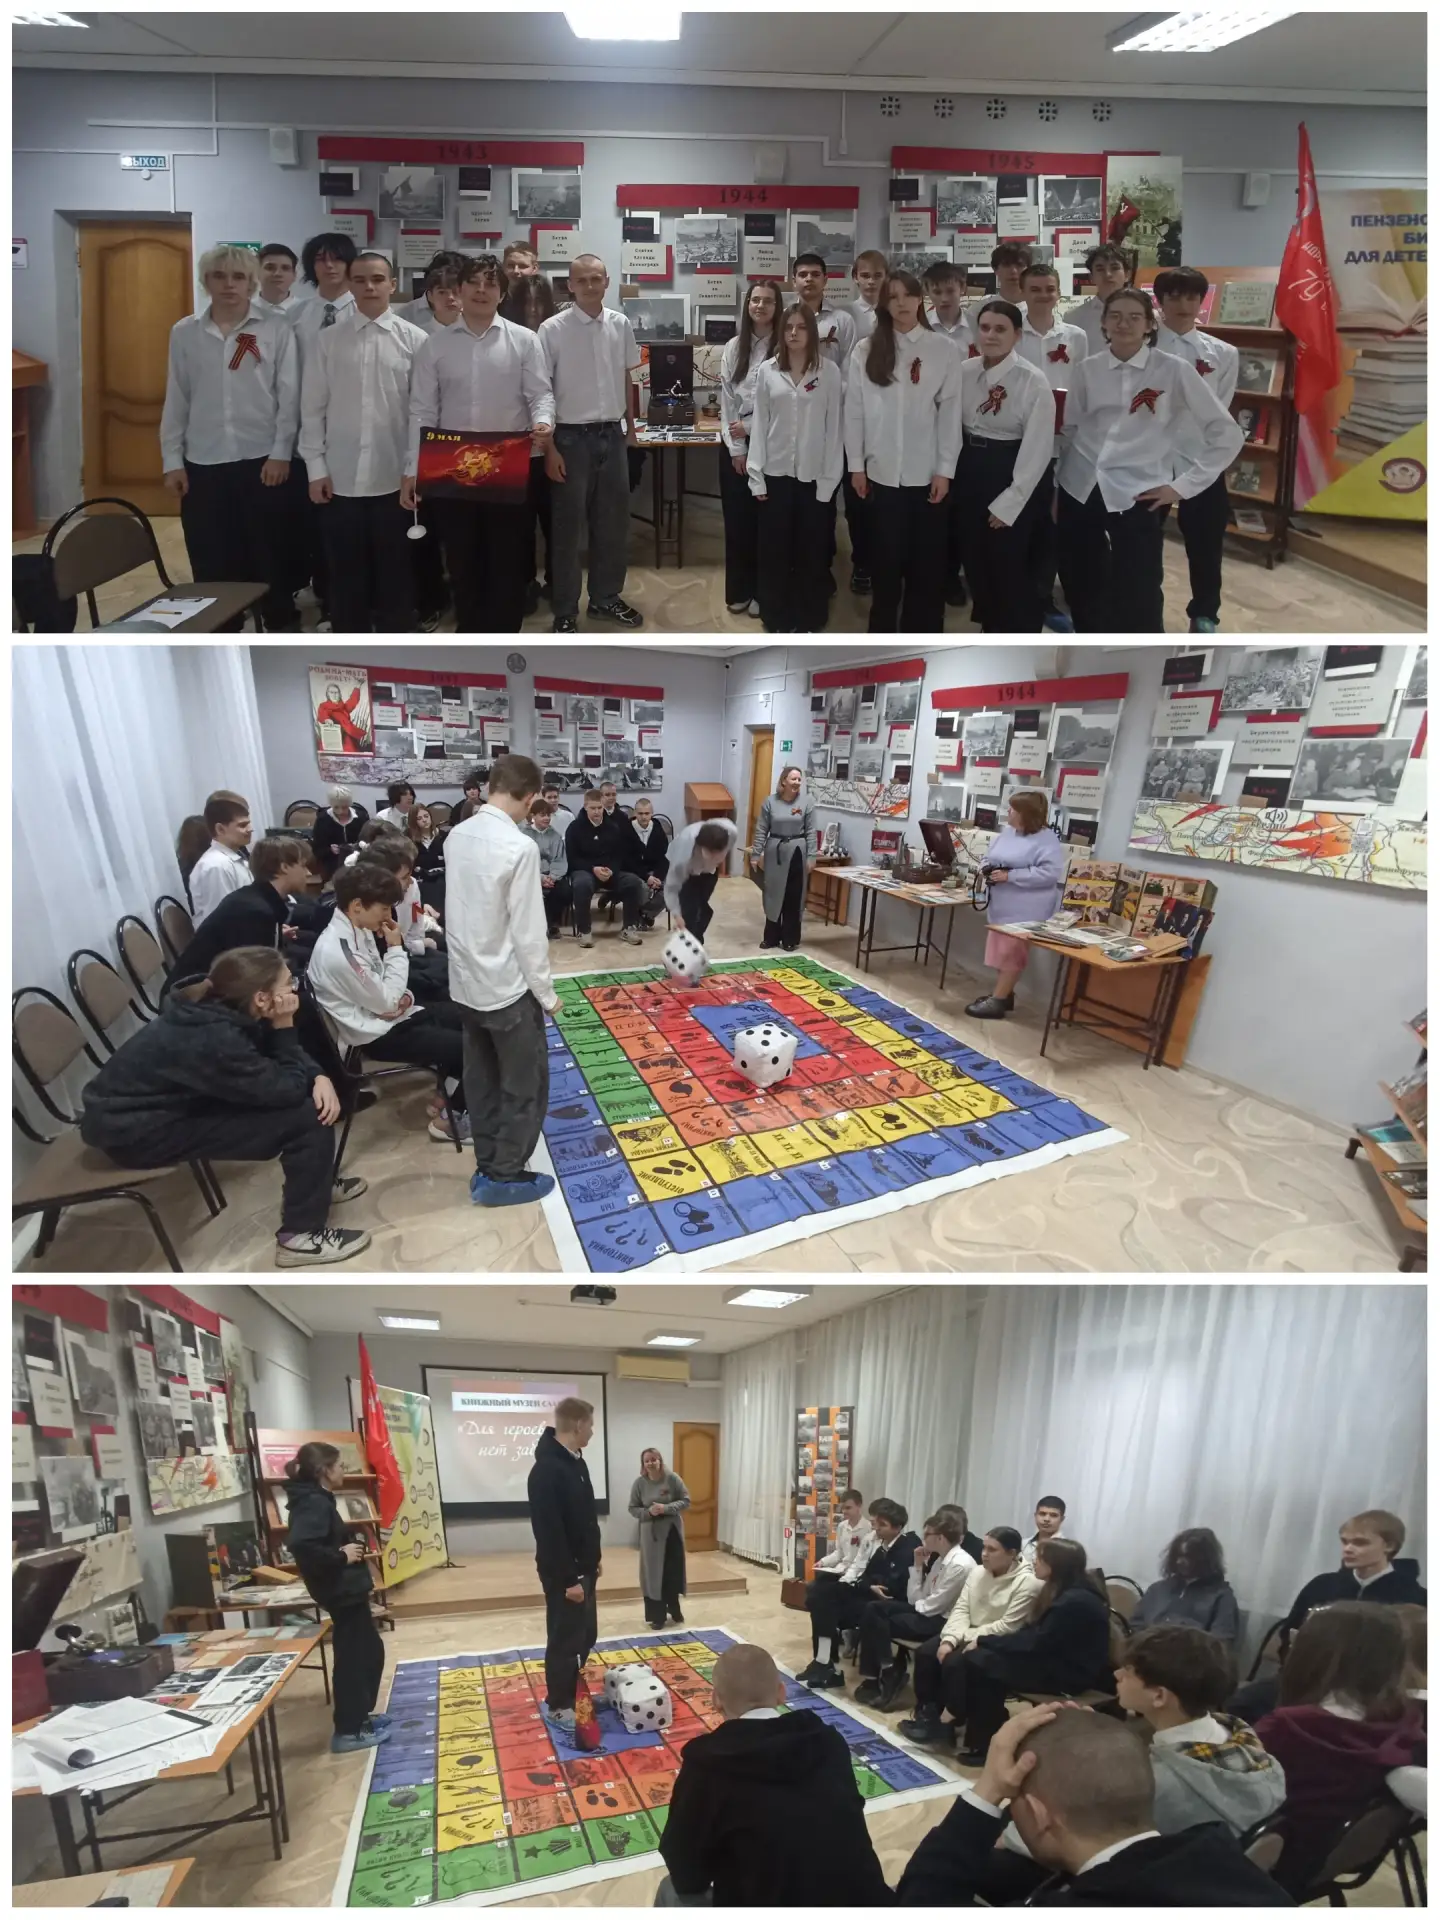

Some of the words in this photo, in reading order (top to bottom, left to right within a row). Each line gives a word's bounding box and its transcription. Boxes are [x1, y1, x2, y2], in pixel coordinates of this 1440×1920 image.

[437, 145, 488, 160] 1943
[989, 154, 1035, 170] 1945
[721, 189, 768, 204] 1944
[1344, 251, 1380, 264] ДЛЯ
[426, 431, 434, 441] 9
[436, 433, 462, 442] МАЯ
[998, 683, 1036, 702] 1944
[637, 1171, 685, 1194] ОТСТУПЛЕНИЕ
[588, 1239, 634, 1266] ВИКТОРИНА
[460, 1397, 511, 1408] КНИЖНЫЙ
[478, 1444, 508, 1457] нет
